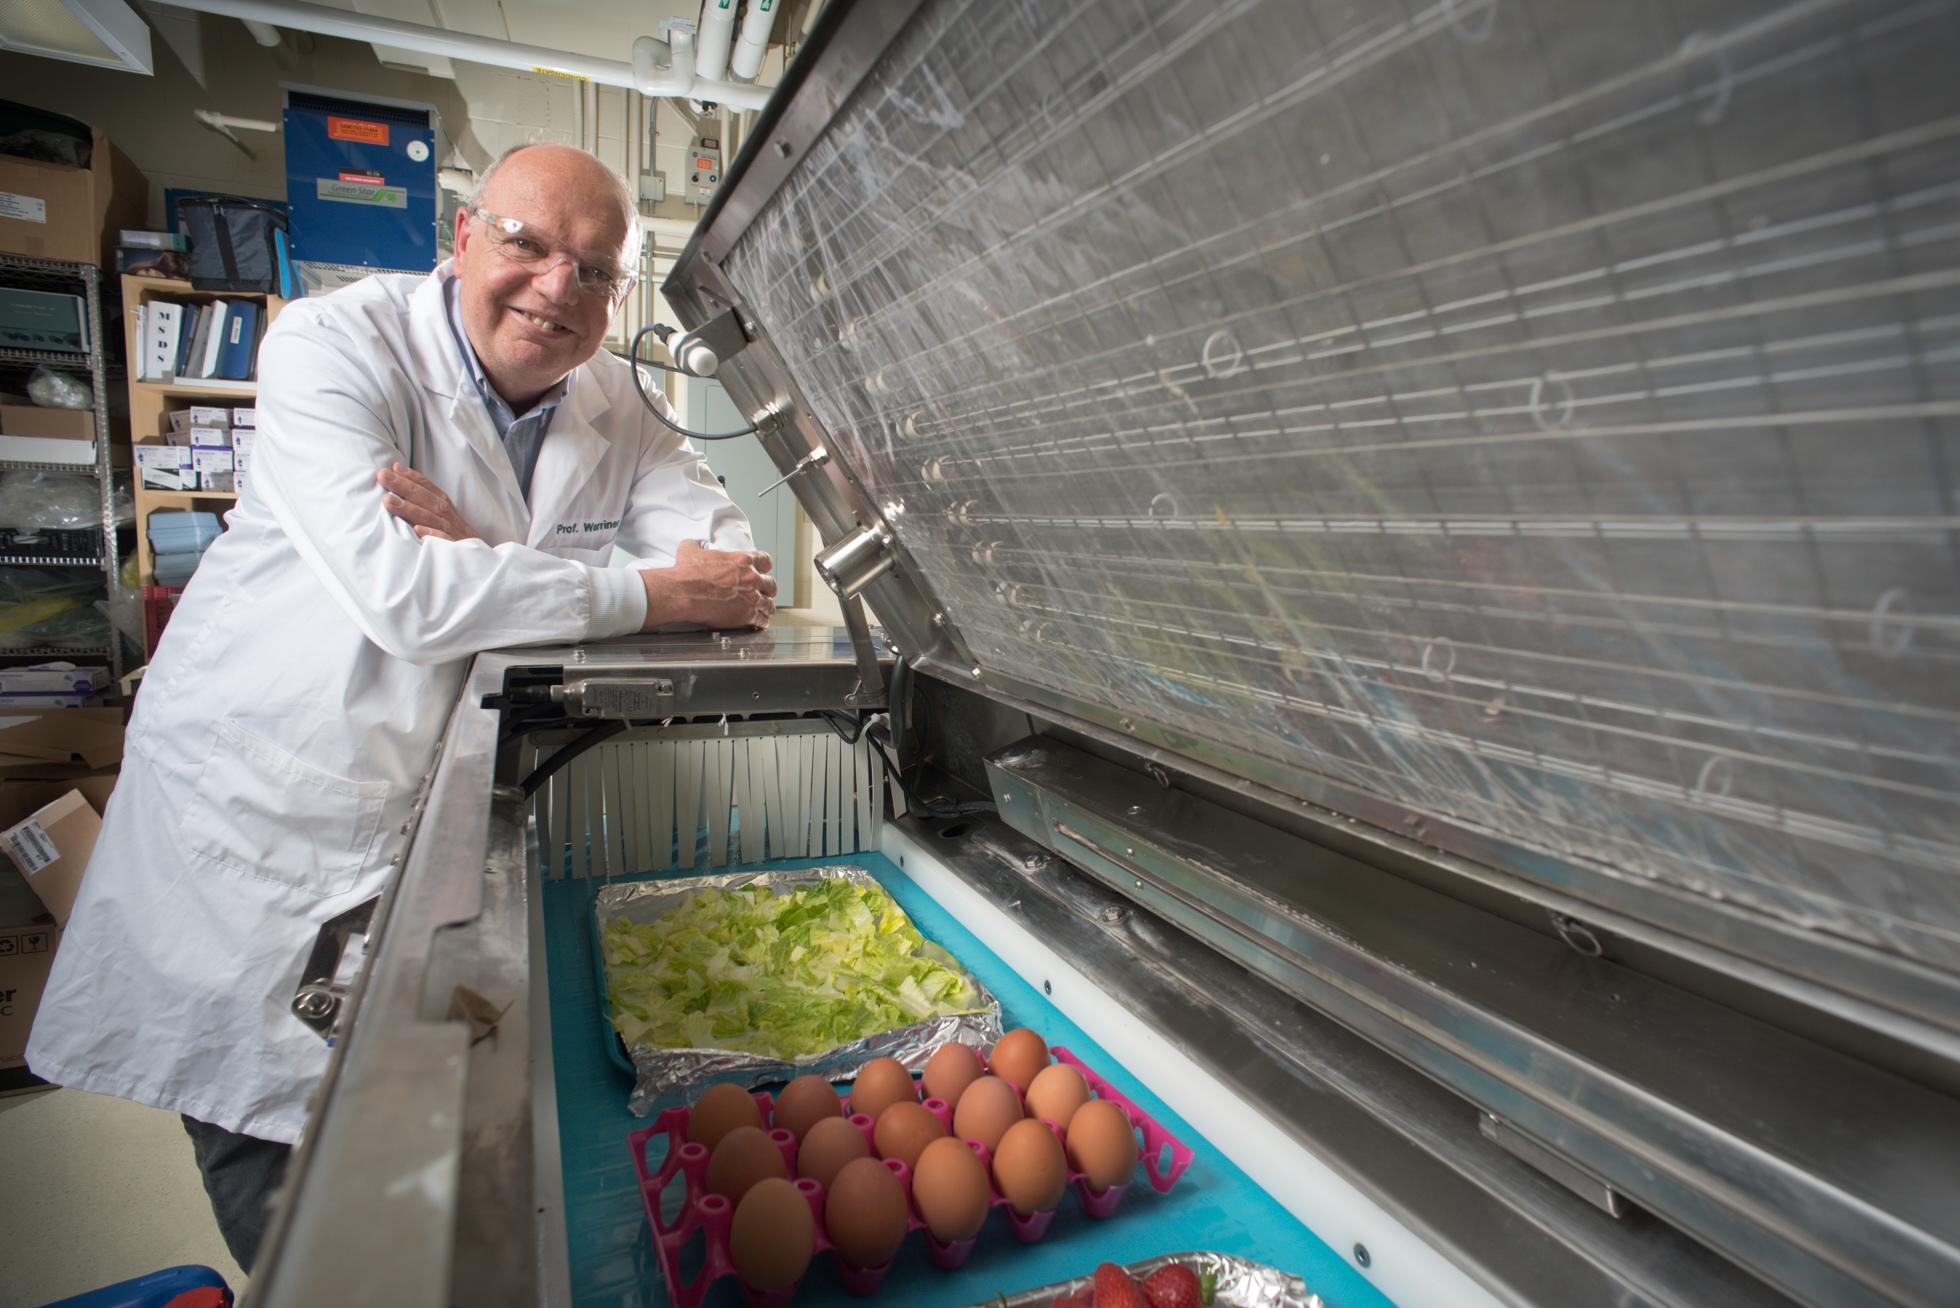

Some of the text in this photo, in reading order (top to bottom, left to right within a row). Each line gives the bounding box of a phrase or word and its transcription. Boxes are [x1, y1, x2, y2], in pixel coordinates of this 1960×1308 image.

[331, 184, 357, 194] Green
[358, 187, 376, 196] Star
[556, 523, 579, 534] Prof.
